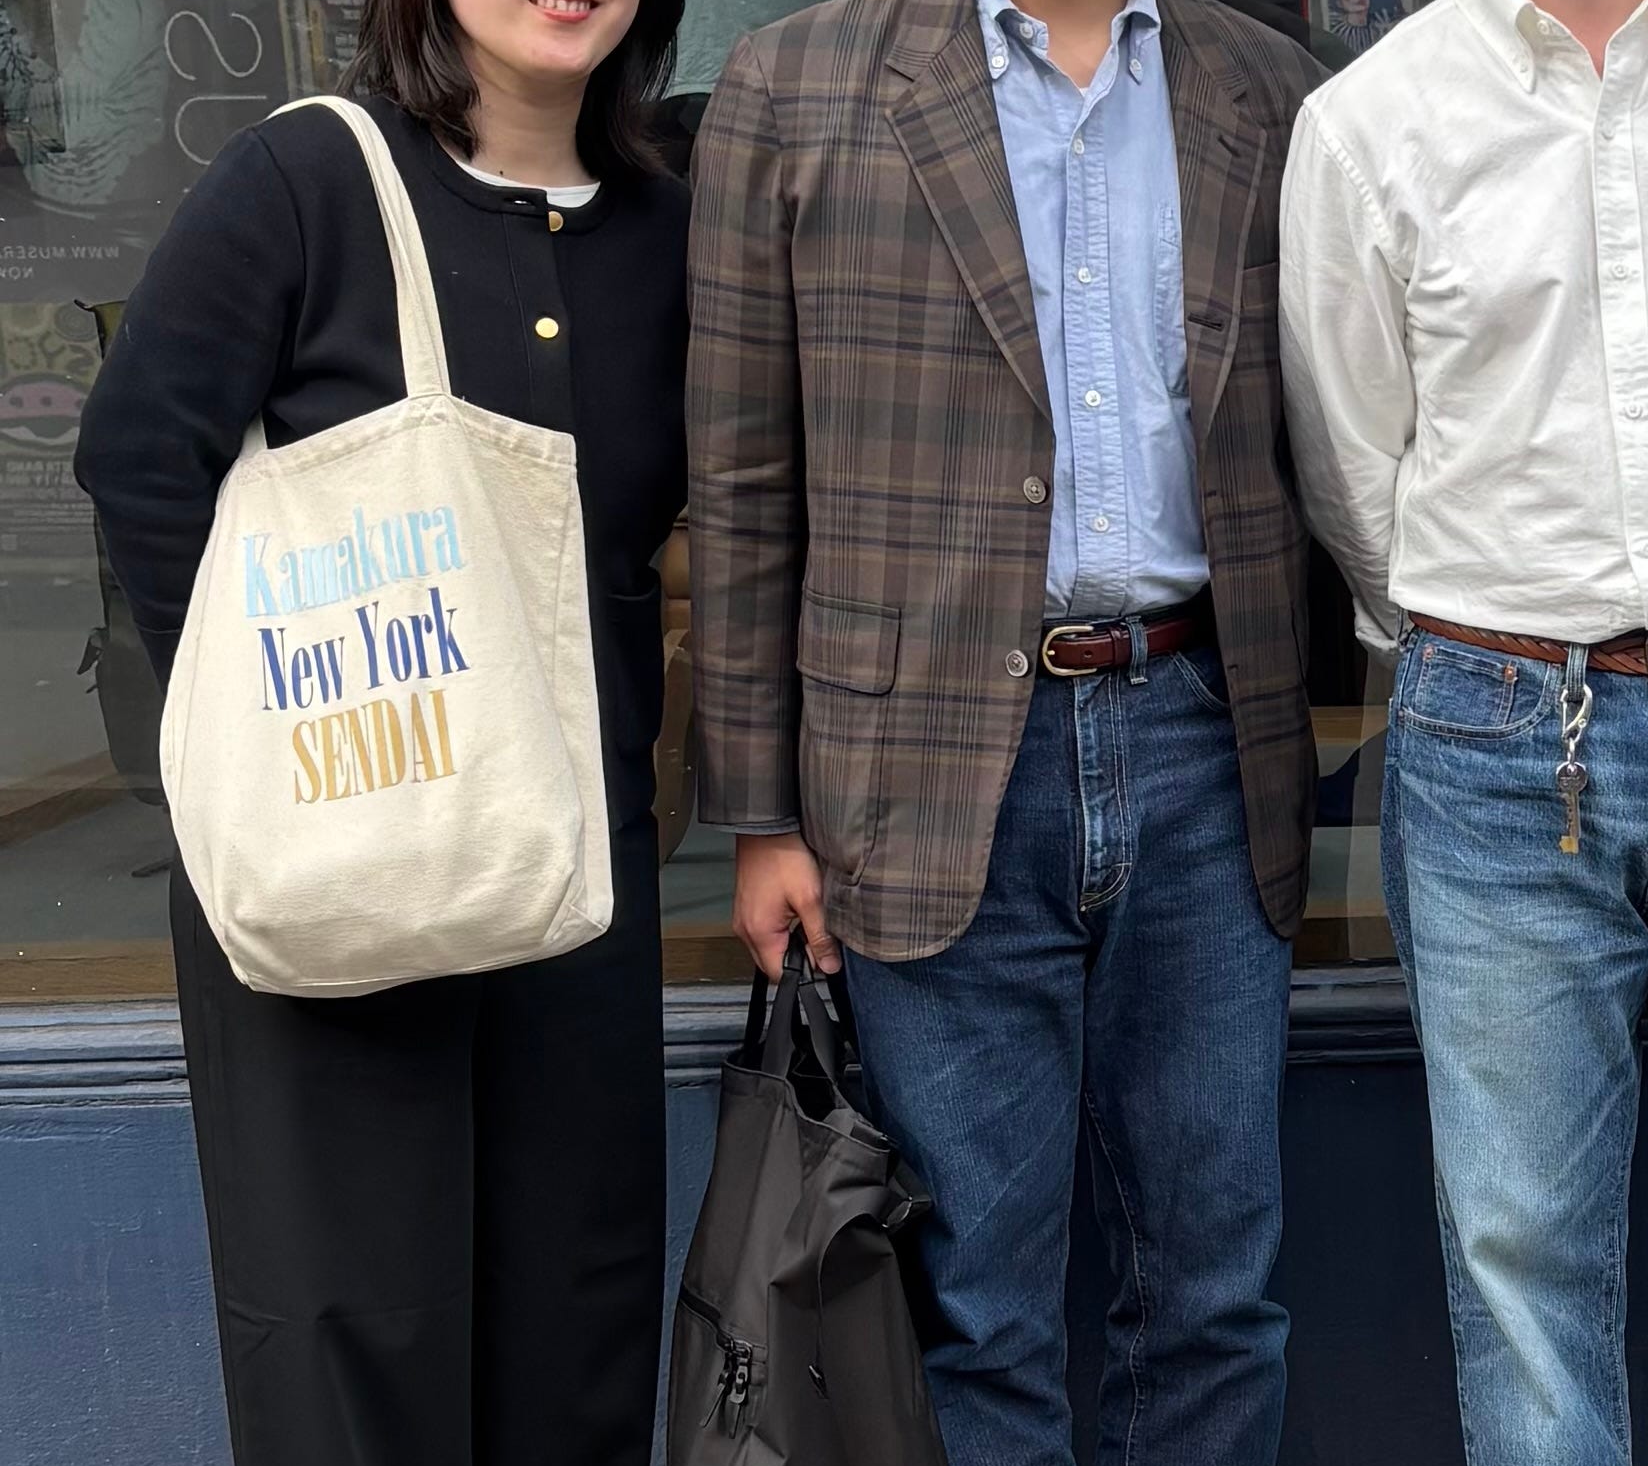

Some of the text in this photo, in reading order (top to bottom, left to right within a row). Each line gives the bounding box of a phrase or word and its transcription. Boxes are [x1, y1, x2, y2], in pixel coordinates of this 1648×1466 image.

[242, 505, 468, 618] Kamakura
[257, 587, 470, 711] New York
[292, 689, 458, 805] SENDAI
